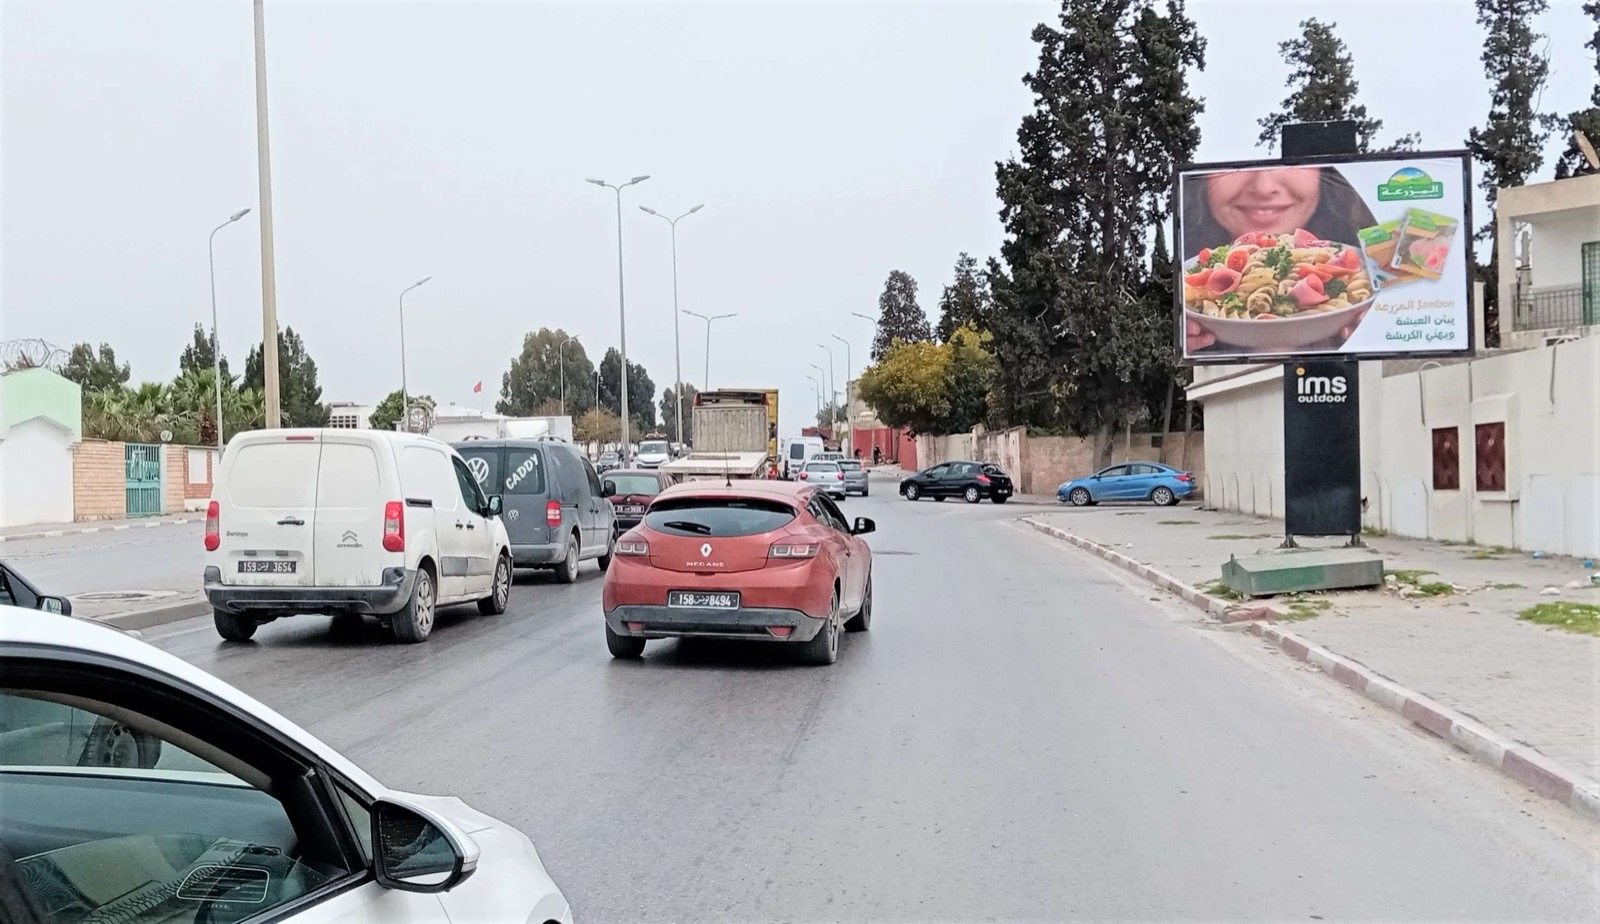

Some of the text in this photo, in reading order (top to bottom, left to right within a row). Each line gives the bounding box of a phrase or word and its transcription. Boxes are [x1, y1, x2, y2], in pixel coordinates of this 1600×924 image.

[1417, 299, 1455, 310] Jambon
[1296, 367, 1347, 394] ims
[1297, 394, 1347, 403] outdoor
[505, 453, 539, 490] CADDY
[243, 561, 257, 572] 159
[273, 561, 292, 572] 3654
[679, 593, 694, 605] 158
[709, 595, 731, 606] 8494
